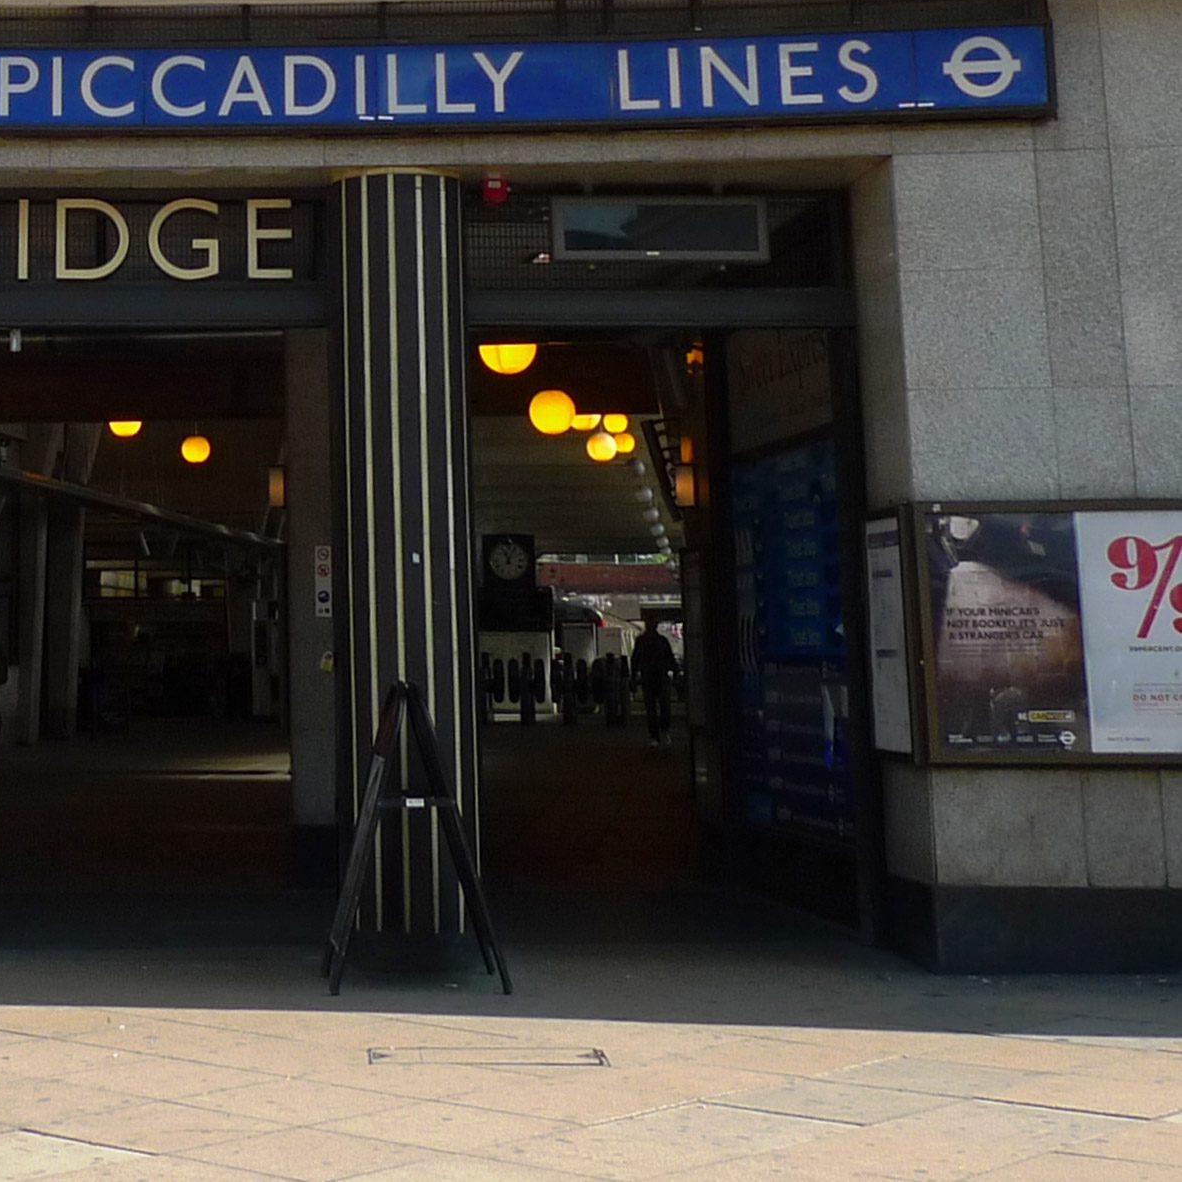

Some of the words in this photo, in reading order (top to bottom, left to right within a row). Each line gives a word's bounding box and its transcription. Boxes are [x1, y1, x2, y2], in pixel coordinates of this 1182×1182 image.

[0, 51, 524, 117] PICCADILLY
[617, 40, 879, 110] LINES
[958, 607, 986, 616] YOUR
[947, 619, 970, 628] NOT
[1022, 630, 1045, 639] CAR
